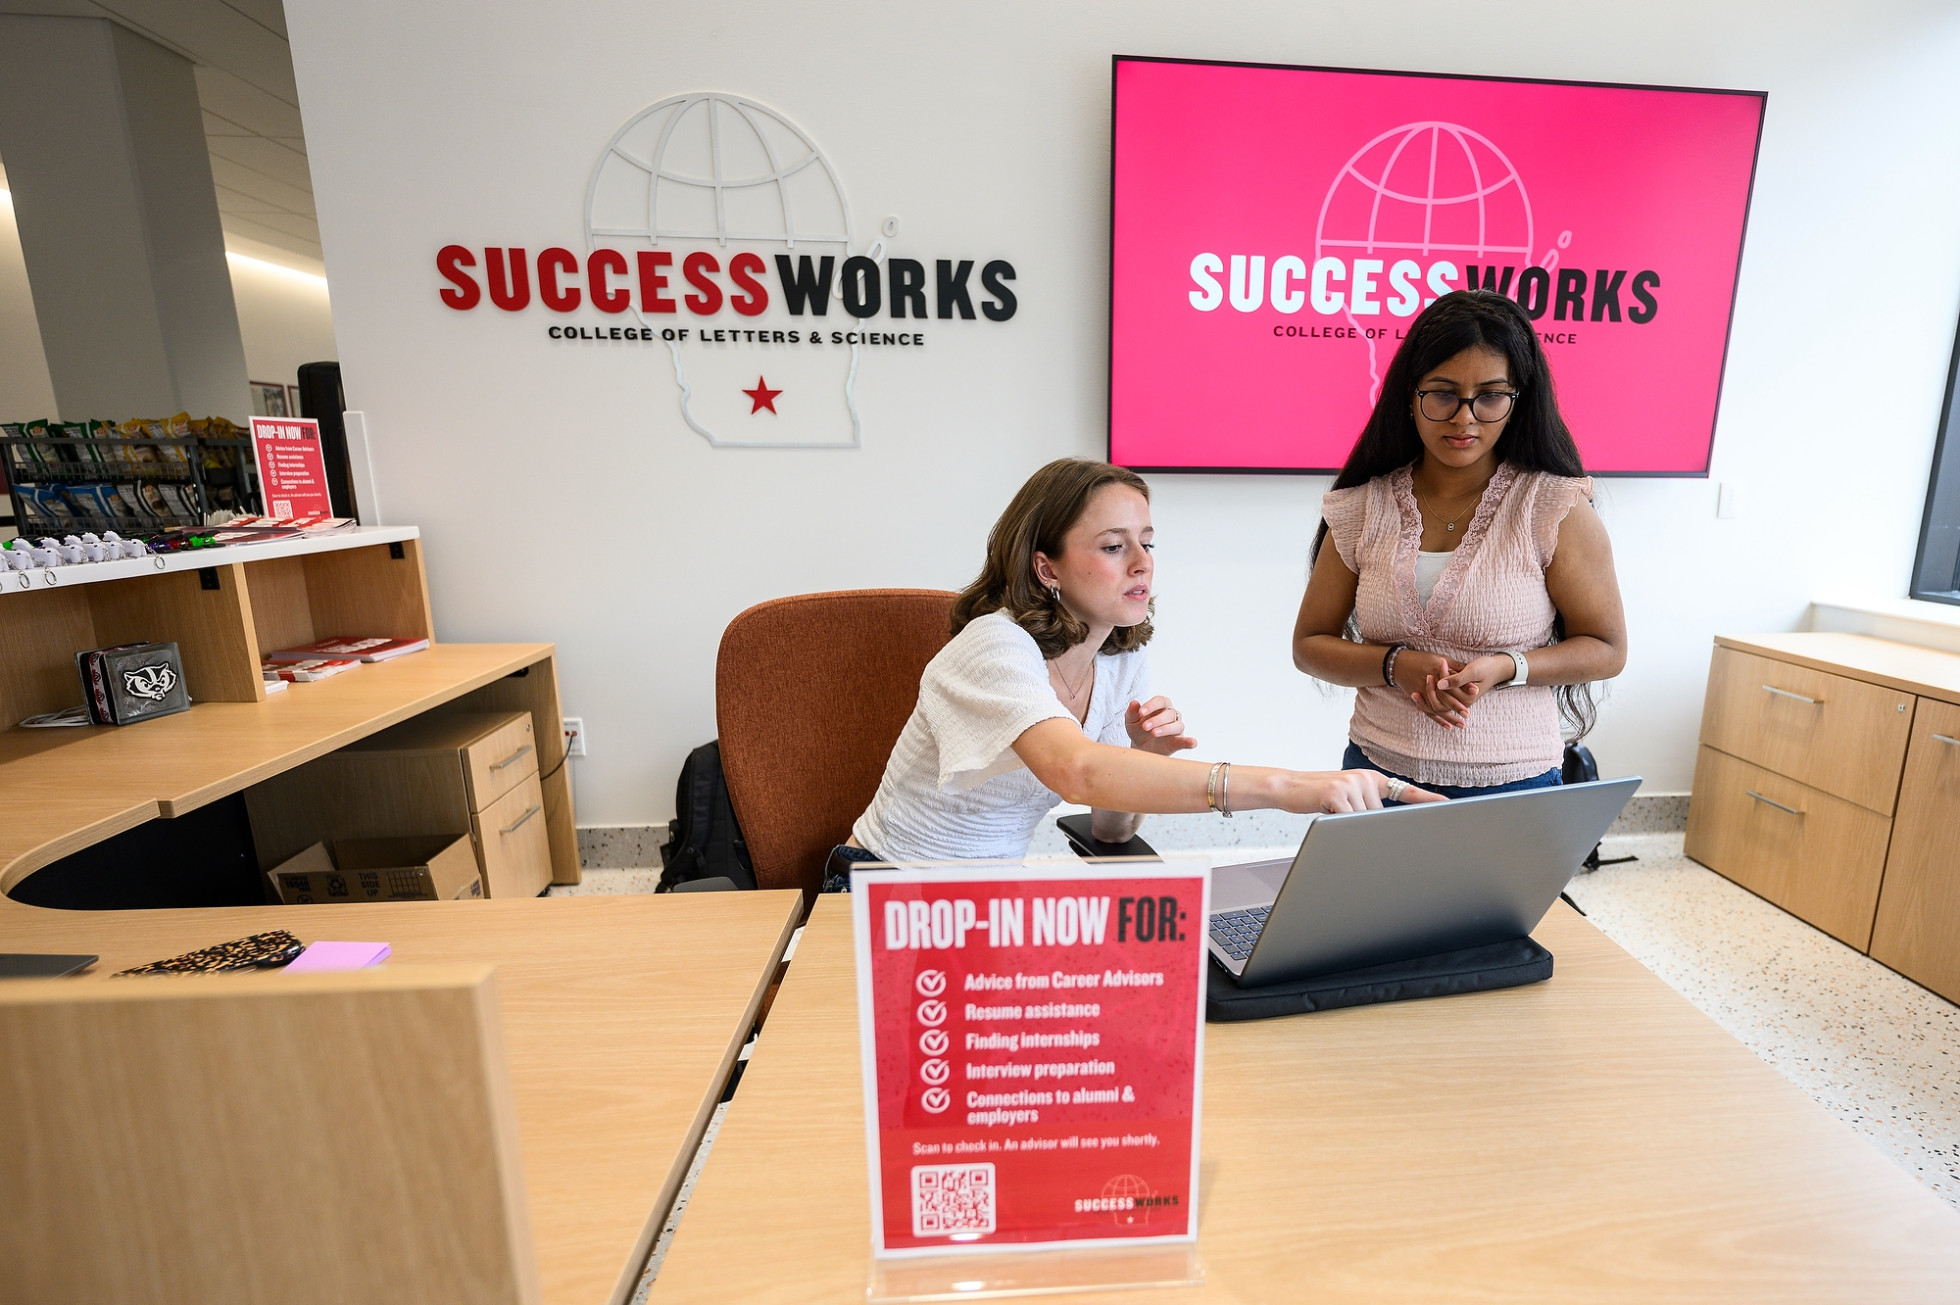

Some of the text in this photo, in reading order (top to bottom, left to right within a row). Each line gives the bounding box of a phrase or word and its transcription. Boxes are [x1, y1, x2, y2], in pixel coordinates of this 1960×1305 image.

[436, 244, 1018, 322] SUCCESSWORKS
[548, 326, 925, 346] COLLEGE OF LETTERS & SCIENCE
[1273, 325, 1357, 339] COLLEGE
[1365, 327, 1388, 340] OF
[884, 896, 1187, 949] DROP-IN NOW FOR:
[964, 969, 1164, 991] Advice from Career Advisors
[964, 1002, 1100, 1021] Resume assistance
[965, 1030, 1100, 1052] Finding internships
[966, 1059, 1115, 1080] Interview preparation
[967, 1086, 1135, 1108] Connections to alumni &
[967, 1108, 1039, 1126] employers
[912, 1132, 1160, 1155] Scan to check in. An advisor will see you shortly.
